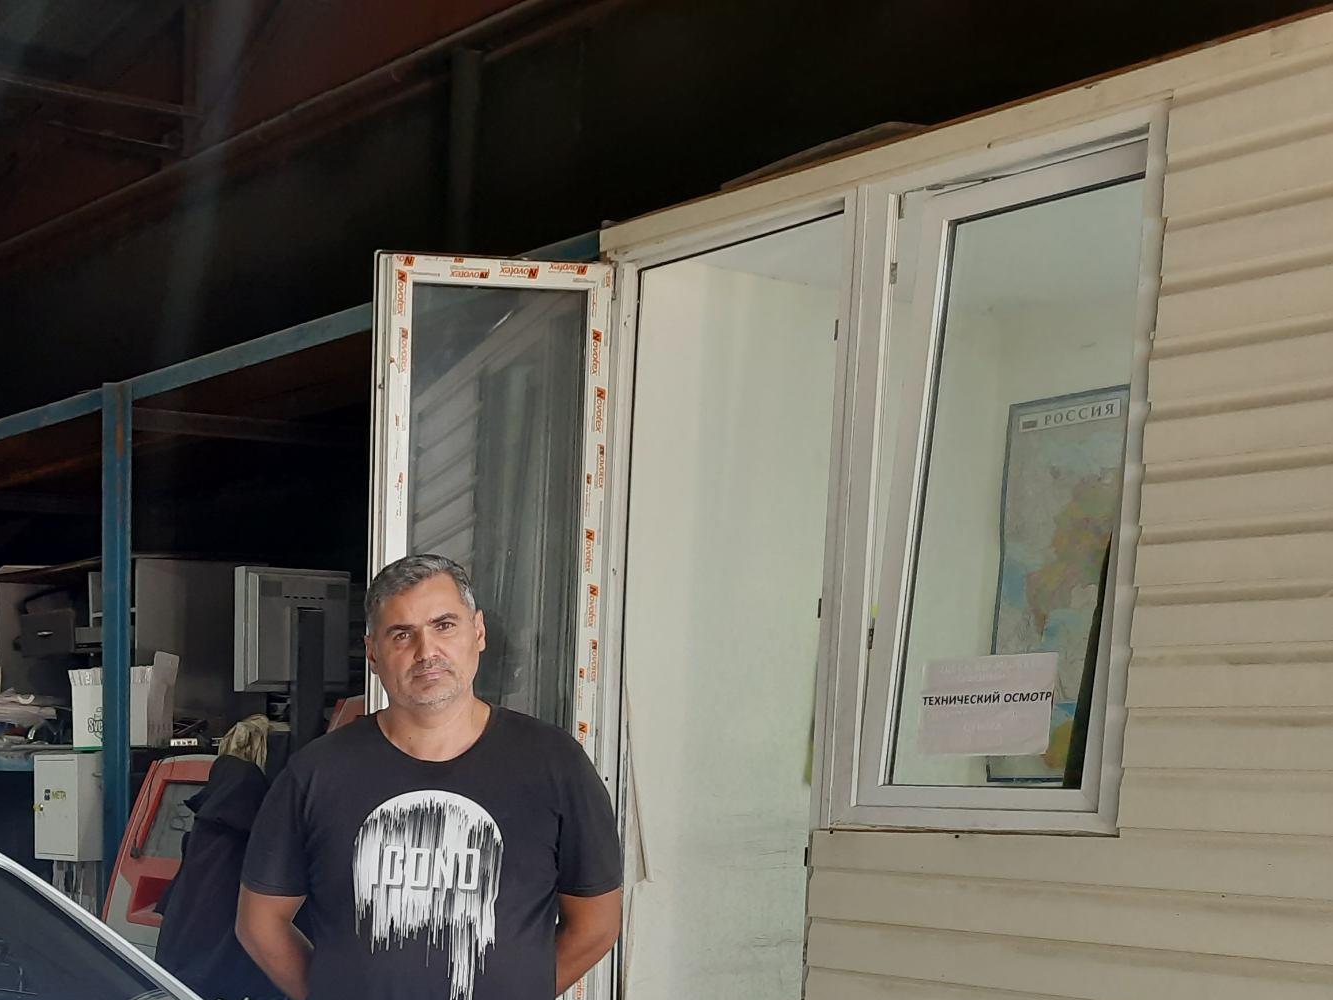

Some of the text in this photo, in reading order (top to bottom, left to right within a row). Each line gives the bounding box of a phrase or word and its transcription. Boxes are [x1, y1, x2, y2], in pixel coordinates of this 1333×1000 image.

[450, 268, 490, 279] Novotex
[499, 265, 539, 279] Novotex
[547, 263, 588, 275] Novotex
[395, 269, 407, 316] Novotex
[399, 327, 408, 374] Novotex
[590, 328, 602, 376] Novotex
[594, 386, 606, 432] Novotex
[1044, 402, 1116, 426] РОССИЯ
[596, 444, 605, 489] Novotex
[584, 528, 595, 574] Novotex
[587, 583, 599, 628] Novotex
[590, 639, 598, 683] Novotex
[922, 691, 1052, 706] ТЕХНИЧЕСКИЙ ОСМОТР
